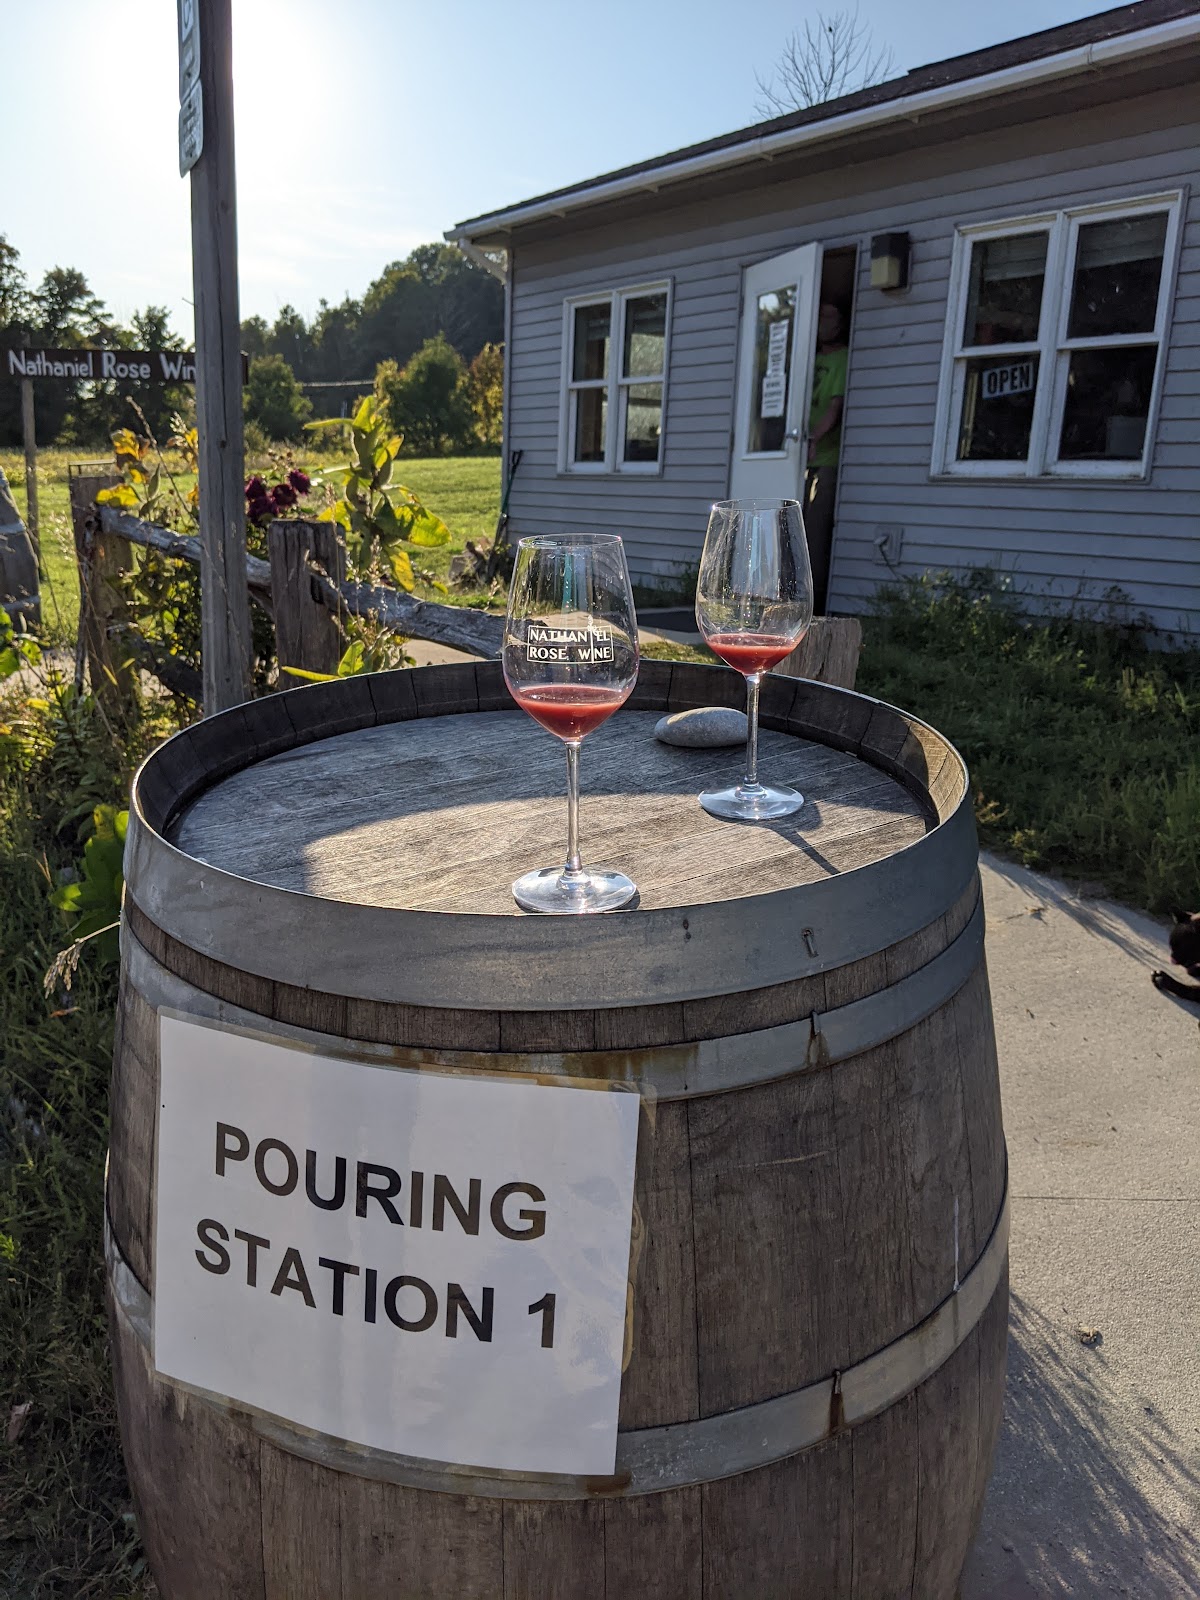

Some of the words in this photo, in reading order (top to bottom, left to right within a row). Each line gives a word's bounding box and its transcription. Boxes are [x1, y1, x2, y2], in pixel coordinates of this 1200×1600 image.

[8, 350, 94, 377] Nathaniel
[101, 351, 151, 379] Rose
[159, 353, 197, 380] Win
[988, 365, 1030, 394] OPEN
[530, 646, 567, 660] ROSE
[578, 646, 611, 660] WINE
[215, 1121, 547, 1241] POURING
[194, 1218, 495, 1343] STATION
[527, 1292, 557, 1349] 1
